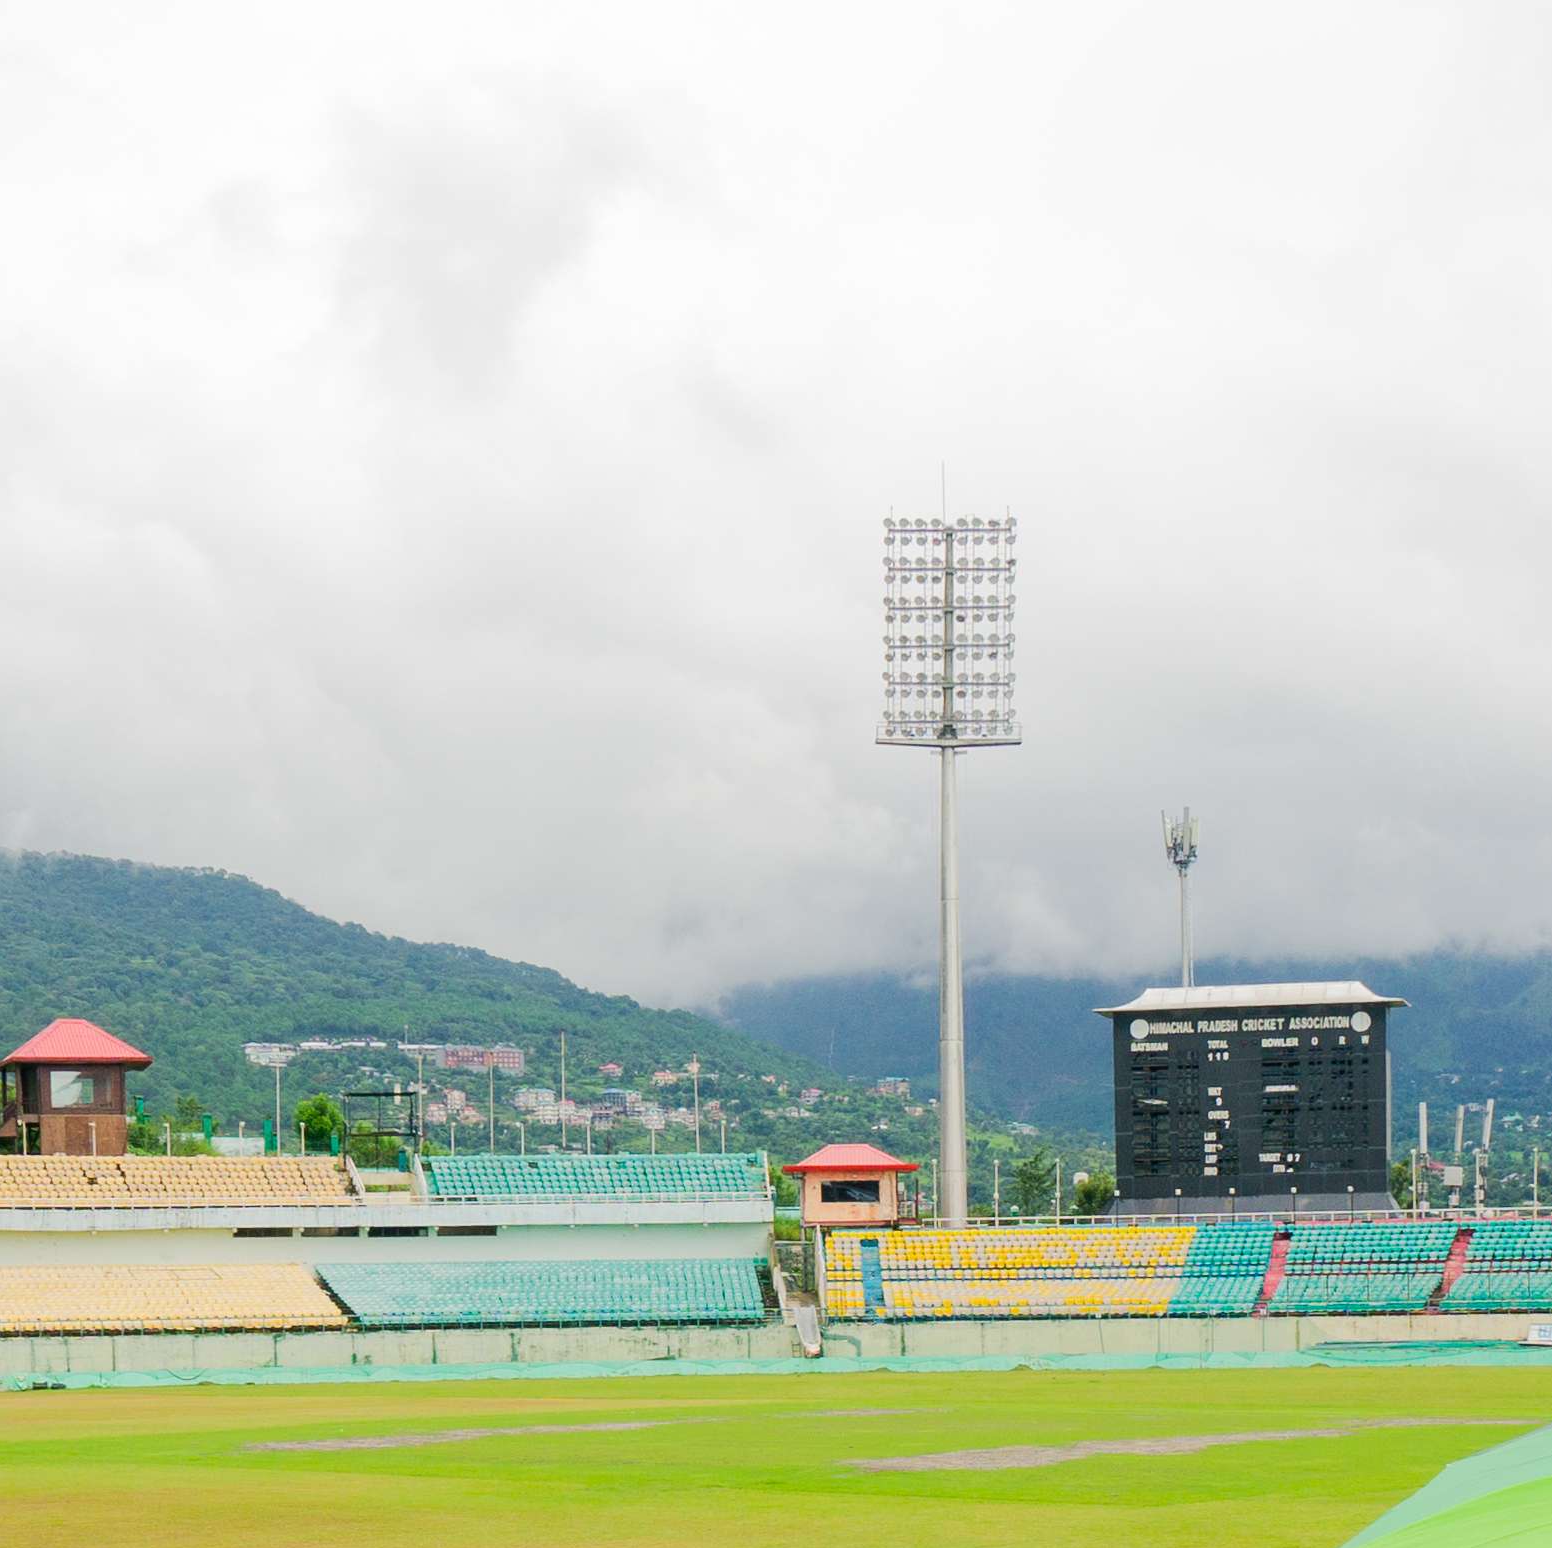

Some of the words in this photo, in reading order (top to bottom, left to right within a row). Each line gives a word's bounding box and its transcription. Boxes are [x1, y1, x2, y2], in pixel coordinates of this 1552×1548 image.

[1149, 1020, 1195, 1034] HIMACHAL
[1197, 1019, 1238, 1033] PRADESH
[1242, 1017, 1285, 1031] CRICKET
[1289, 1015, 1350, 1030] ASSOCIATION
[1207, 1040, 1229, 1050] TOTAL
[1261, 1036, 1299, 1048] BOWLER
